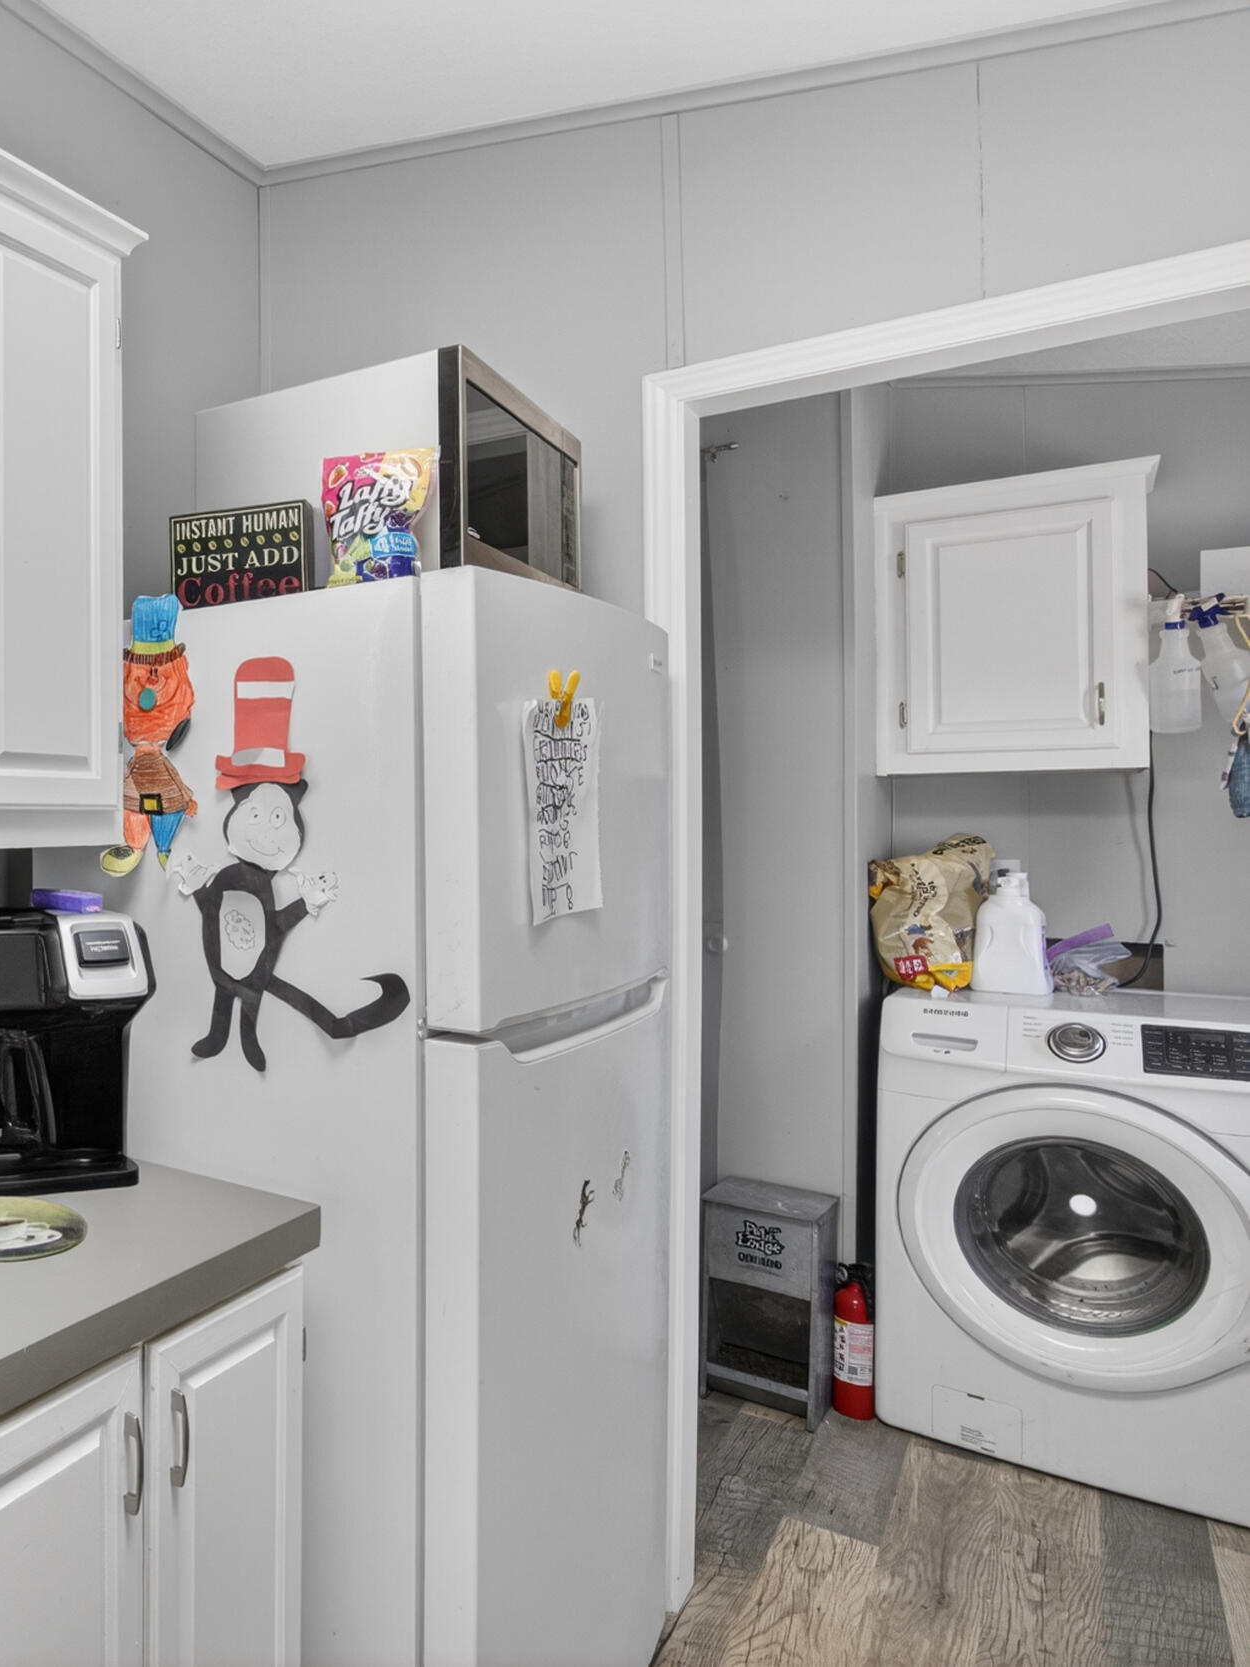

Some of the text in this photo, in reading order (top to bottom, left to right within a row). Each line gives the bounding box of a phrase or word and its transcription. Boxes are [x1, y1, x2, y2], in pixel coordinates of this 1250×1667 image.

[336, 474, 413, 511] Laffy
[176, 508, 299, 541] INSTANT HUMAN
[329, 501, 387, 541] Taffy
[177, 545, 300, 576] JUST ADD
[177, 572, 301, 607] Coffee
